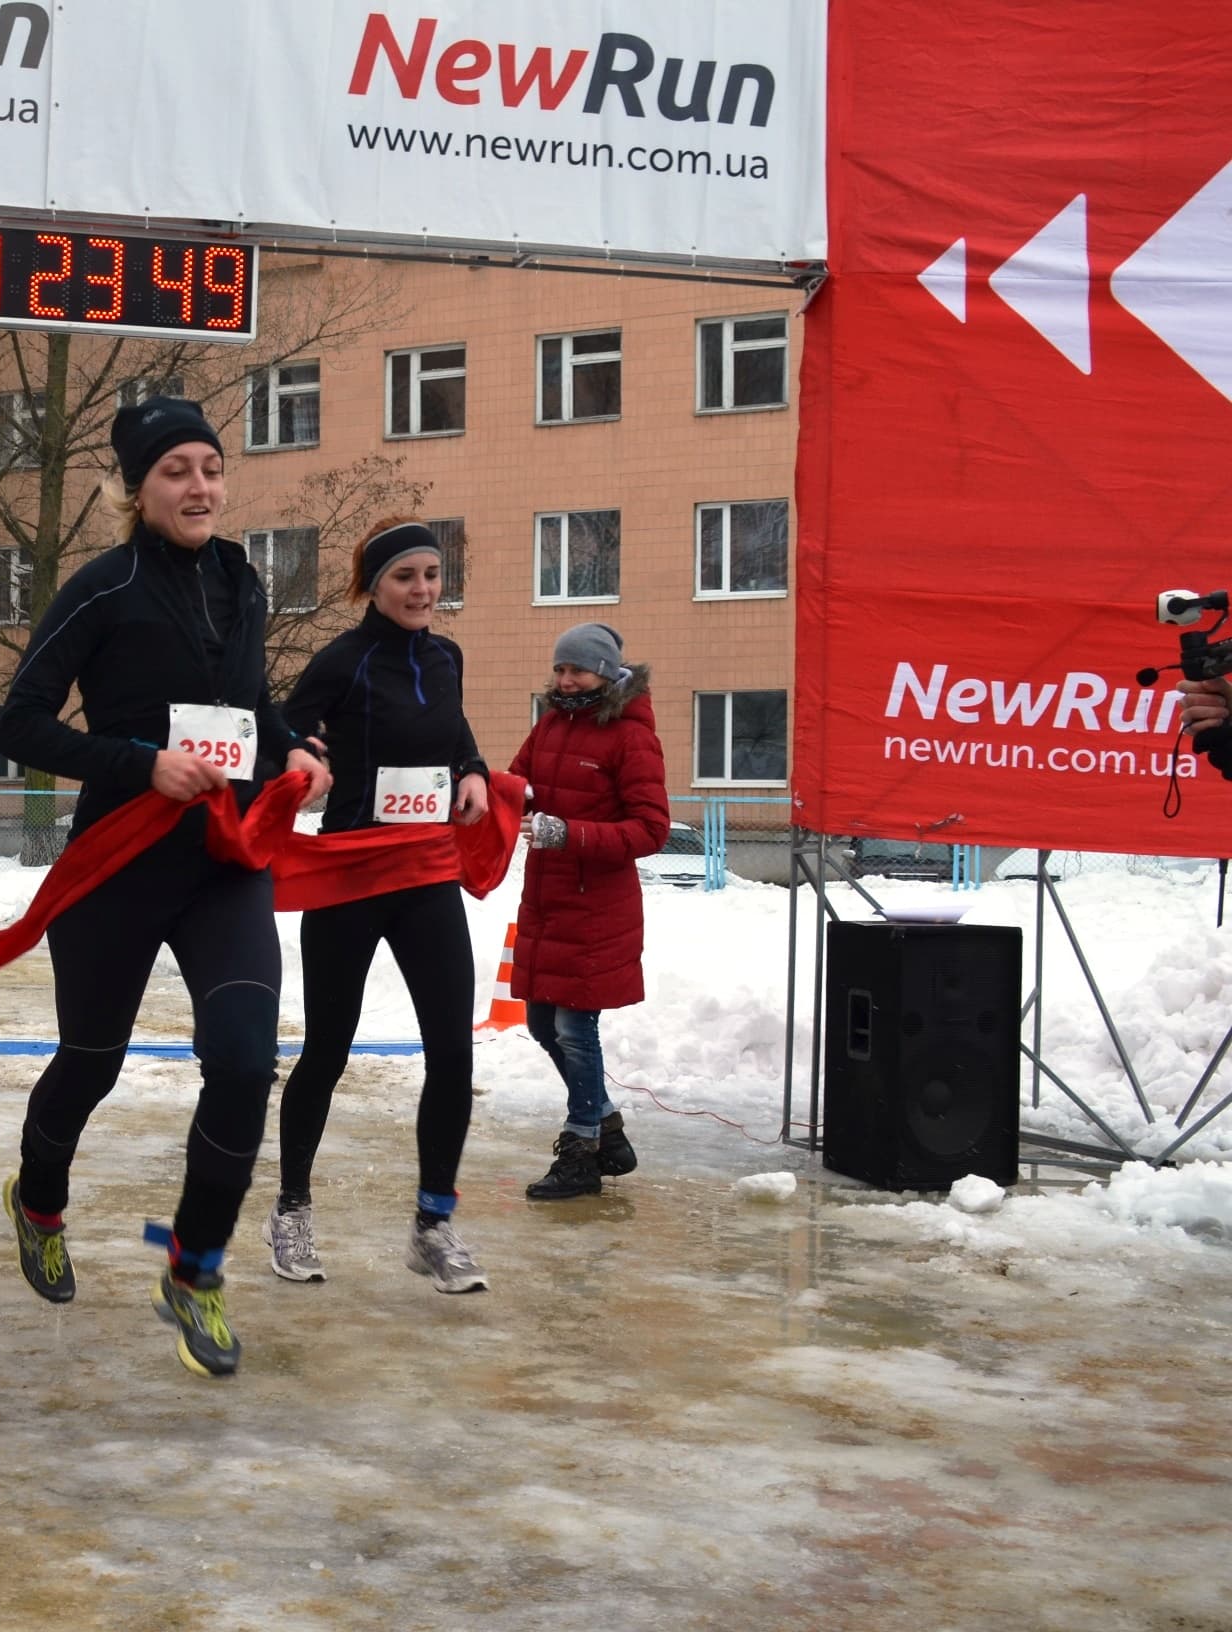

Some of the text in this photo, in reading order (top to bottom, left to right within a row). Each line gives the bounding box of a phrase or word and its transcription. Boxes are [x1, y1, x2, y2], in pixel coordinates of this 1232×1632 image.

[348, 13, 776, 128] NewRun
[347, 123, 769, 179] www.newrun.com.ua
[884, 735, 1198, 778] newrun.com.ua
[382, 793, 437, 815] 2266
